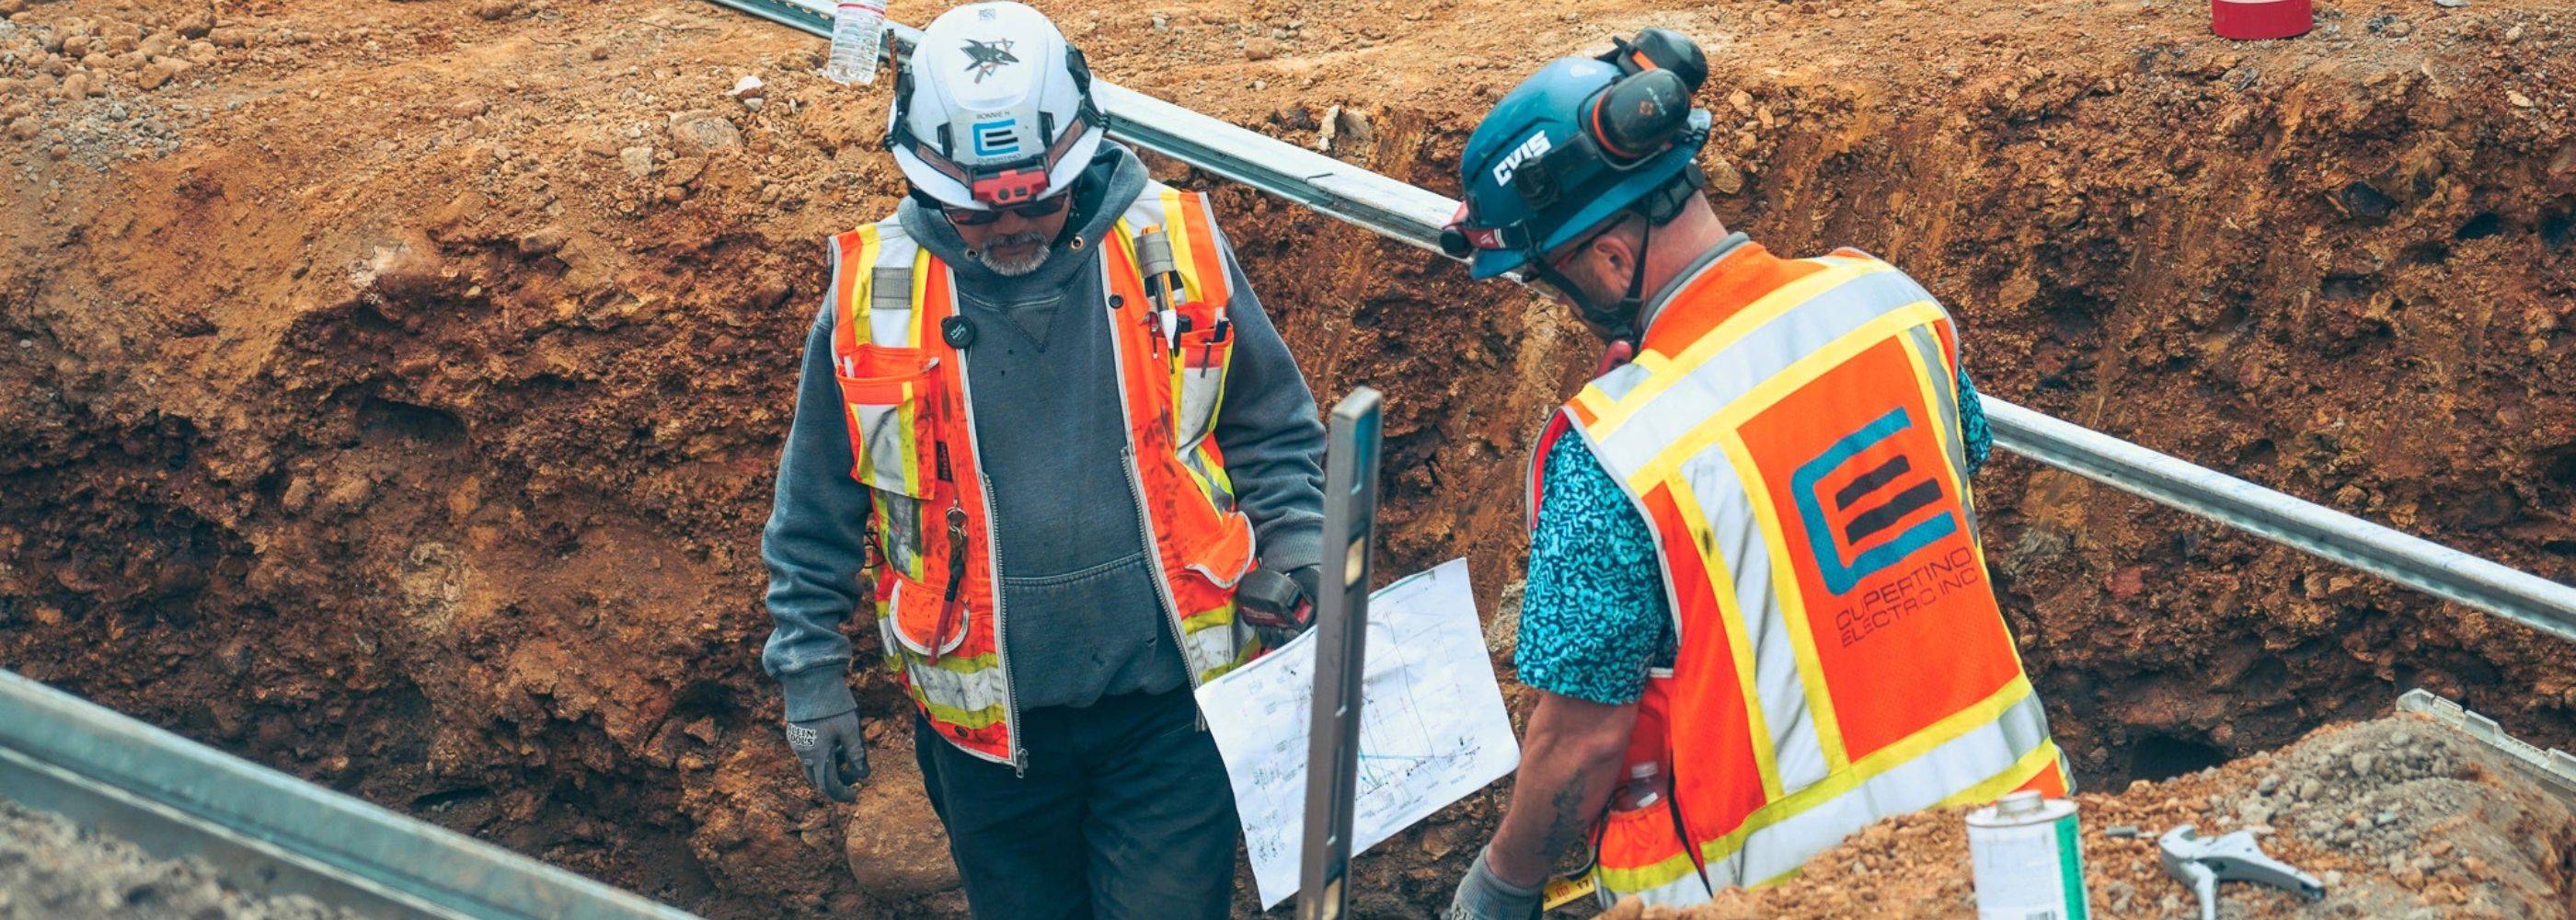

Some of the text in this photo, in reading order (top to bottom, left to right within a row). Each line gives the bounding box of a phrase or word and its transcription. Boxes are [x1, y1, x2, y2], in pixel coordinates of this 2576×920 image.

[1492, 130, 1552, 187] CVIS
[1835, 546, 1972, 631] CUPERTINO
[1841, 567, 1978, 648] ELECTRIC INC
